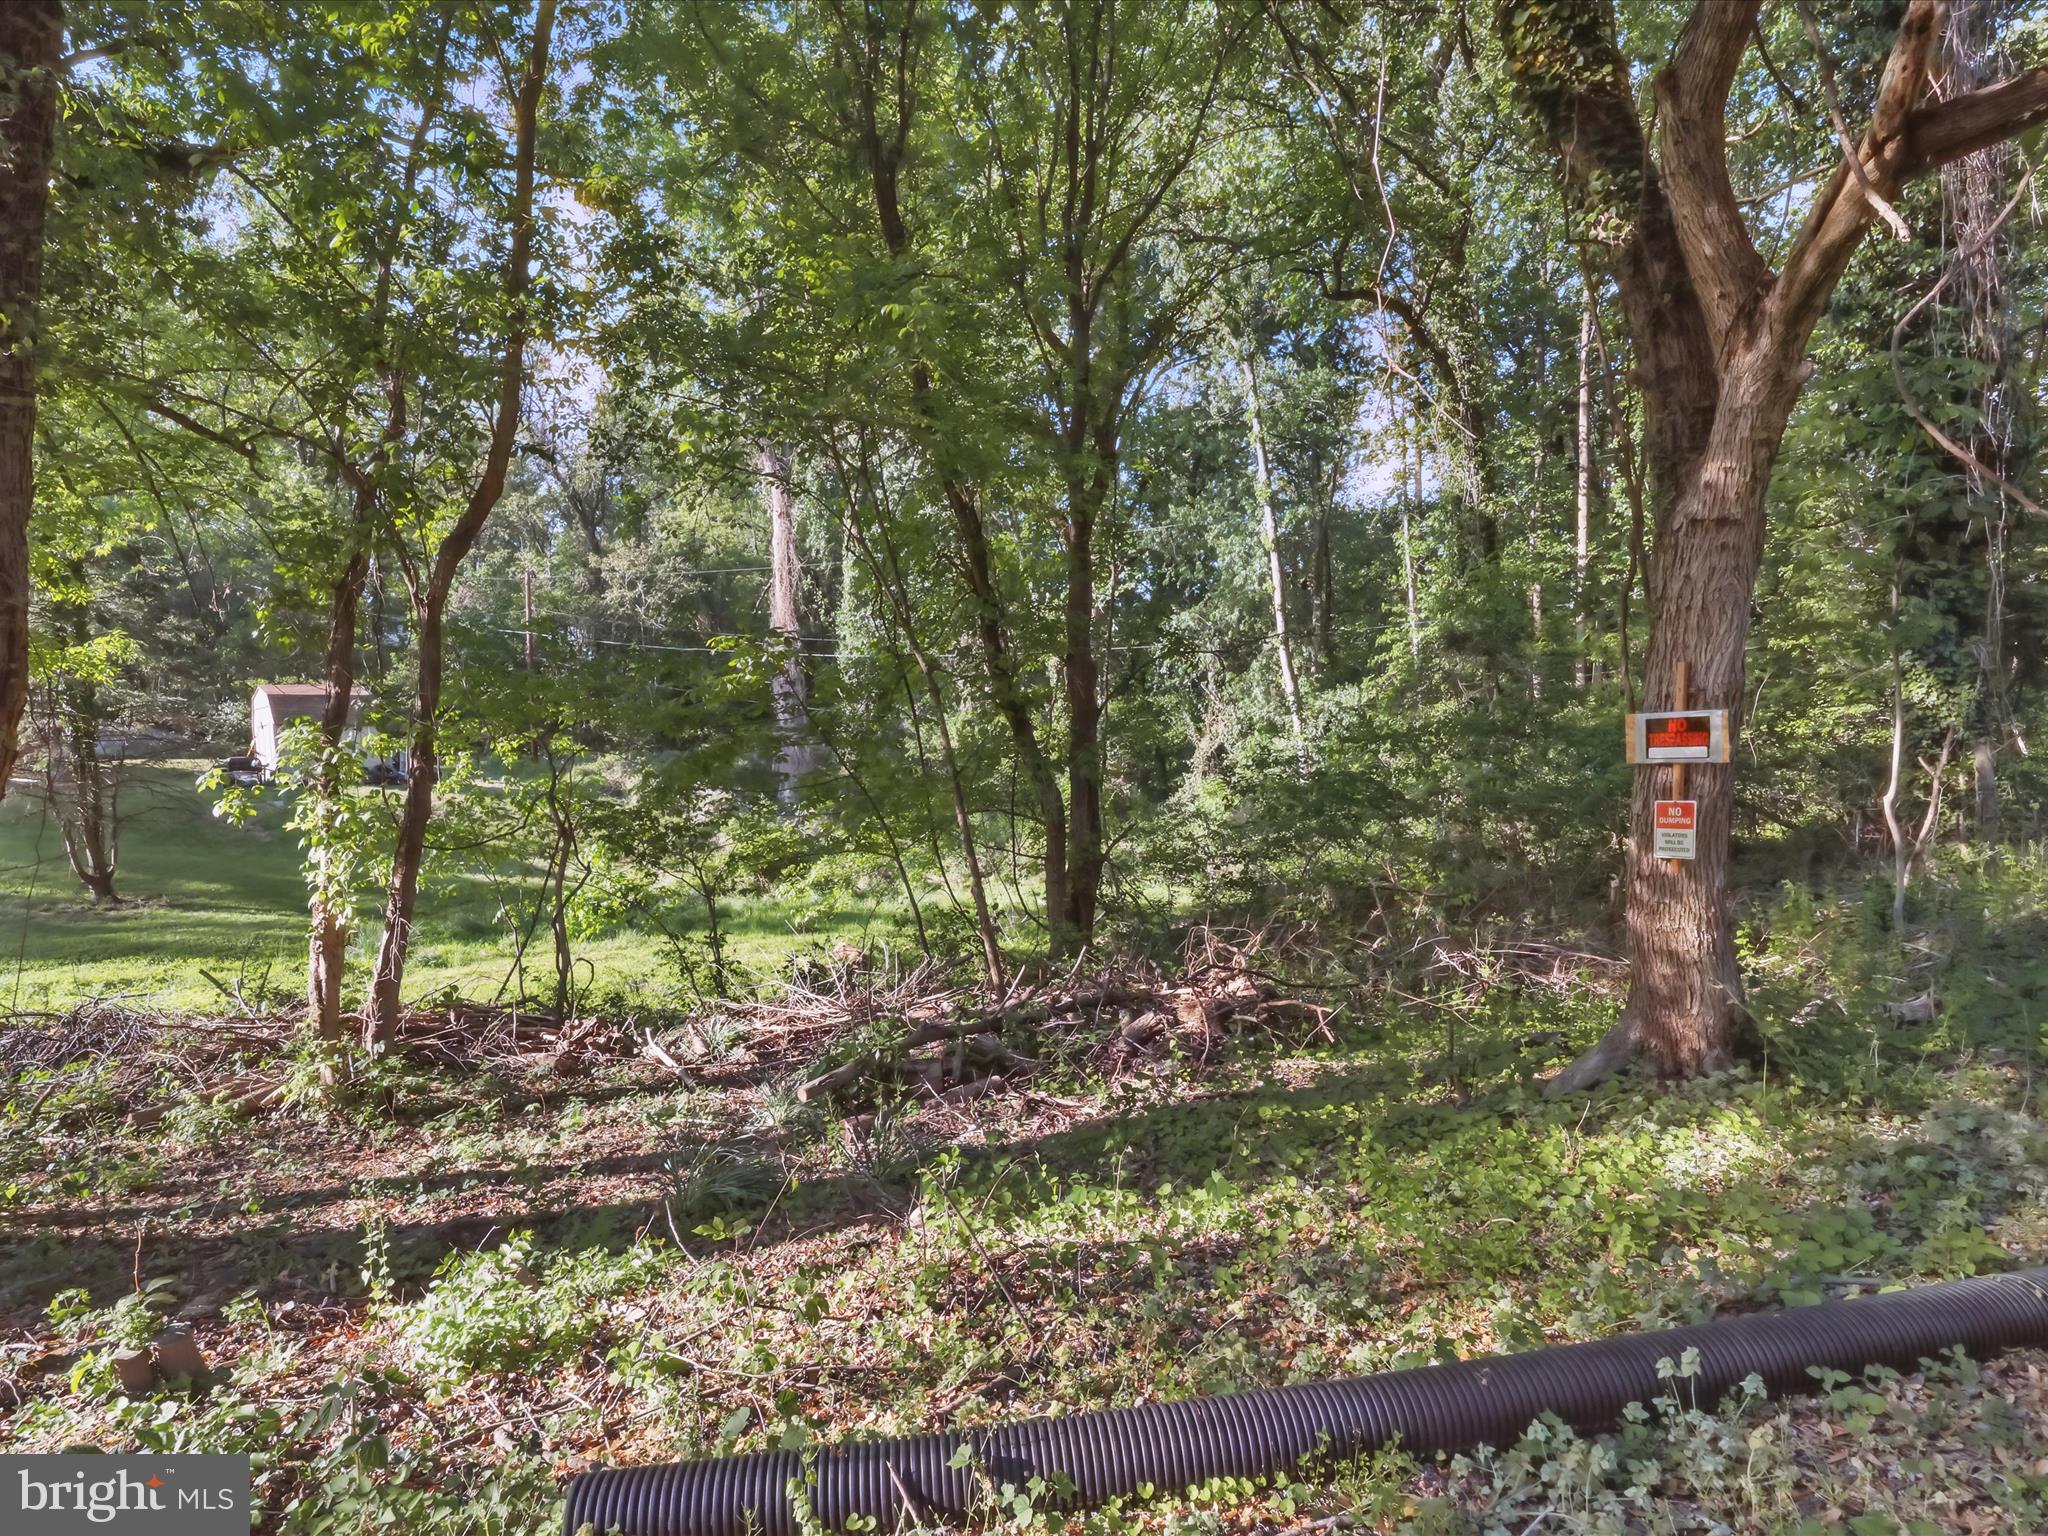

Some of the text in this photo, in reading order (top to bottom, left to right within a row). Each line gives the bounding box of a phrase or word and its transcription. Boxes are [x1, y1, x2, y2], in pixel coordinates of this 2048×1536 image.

[1667, 718, 1687, 732] NO
[1668, 807, 1682, 817] NO
[1659, 816, 1692, 825] DUMPING
